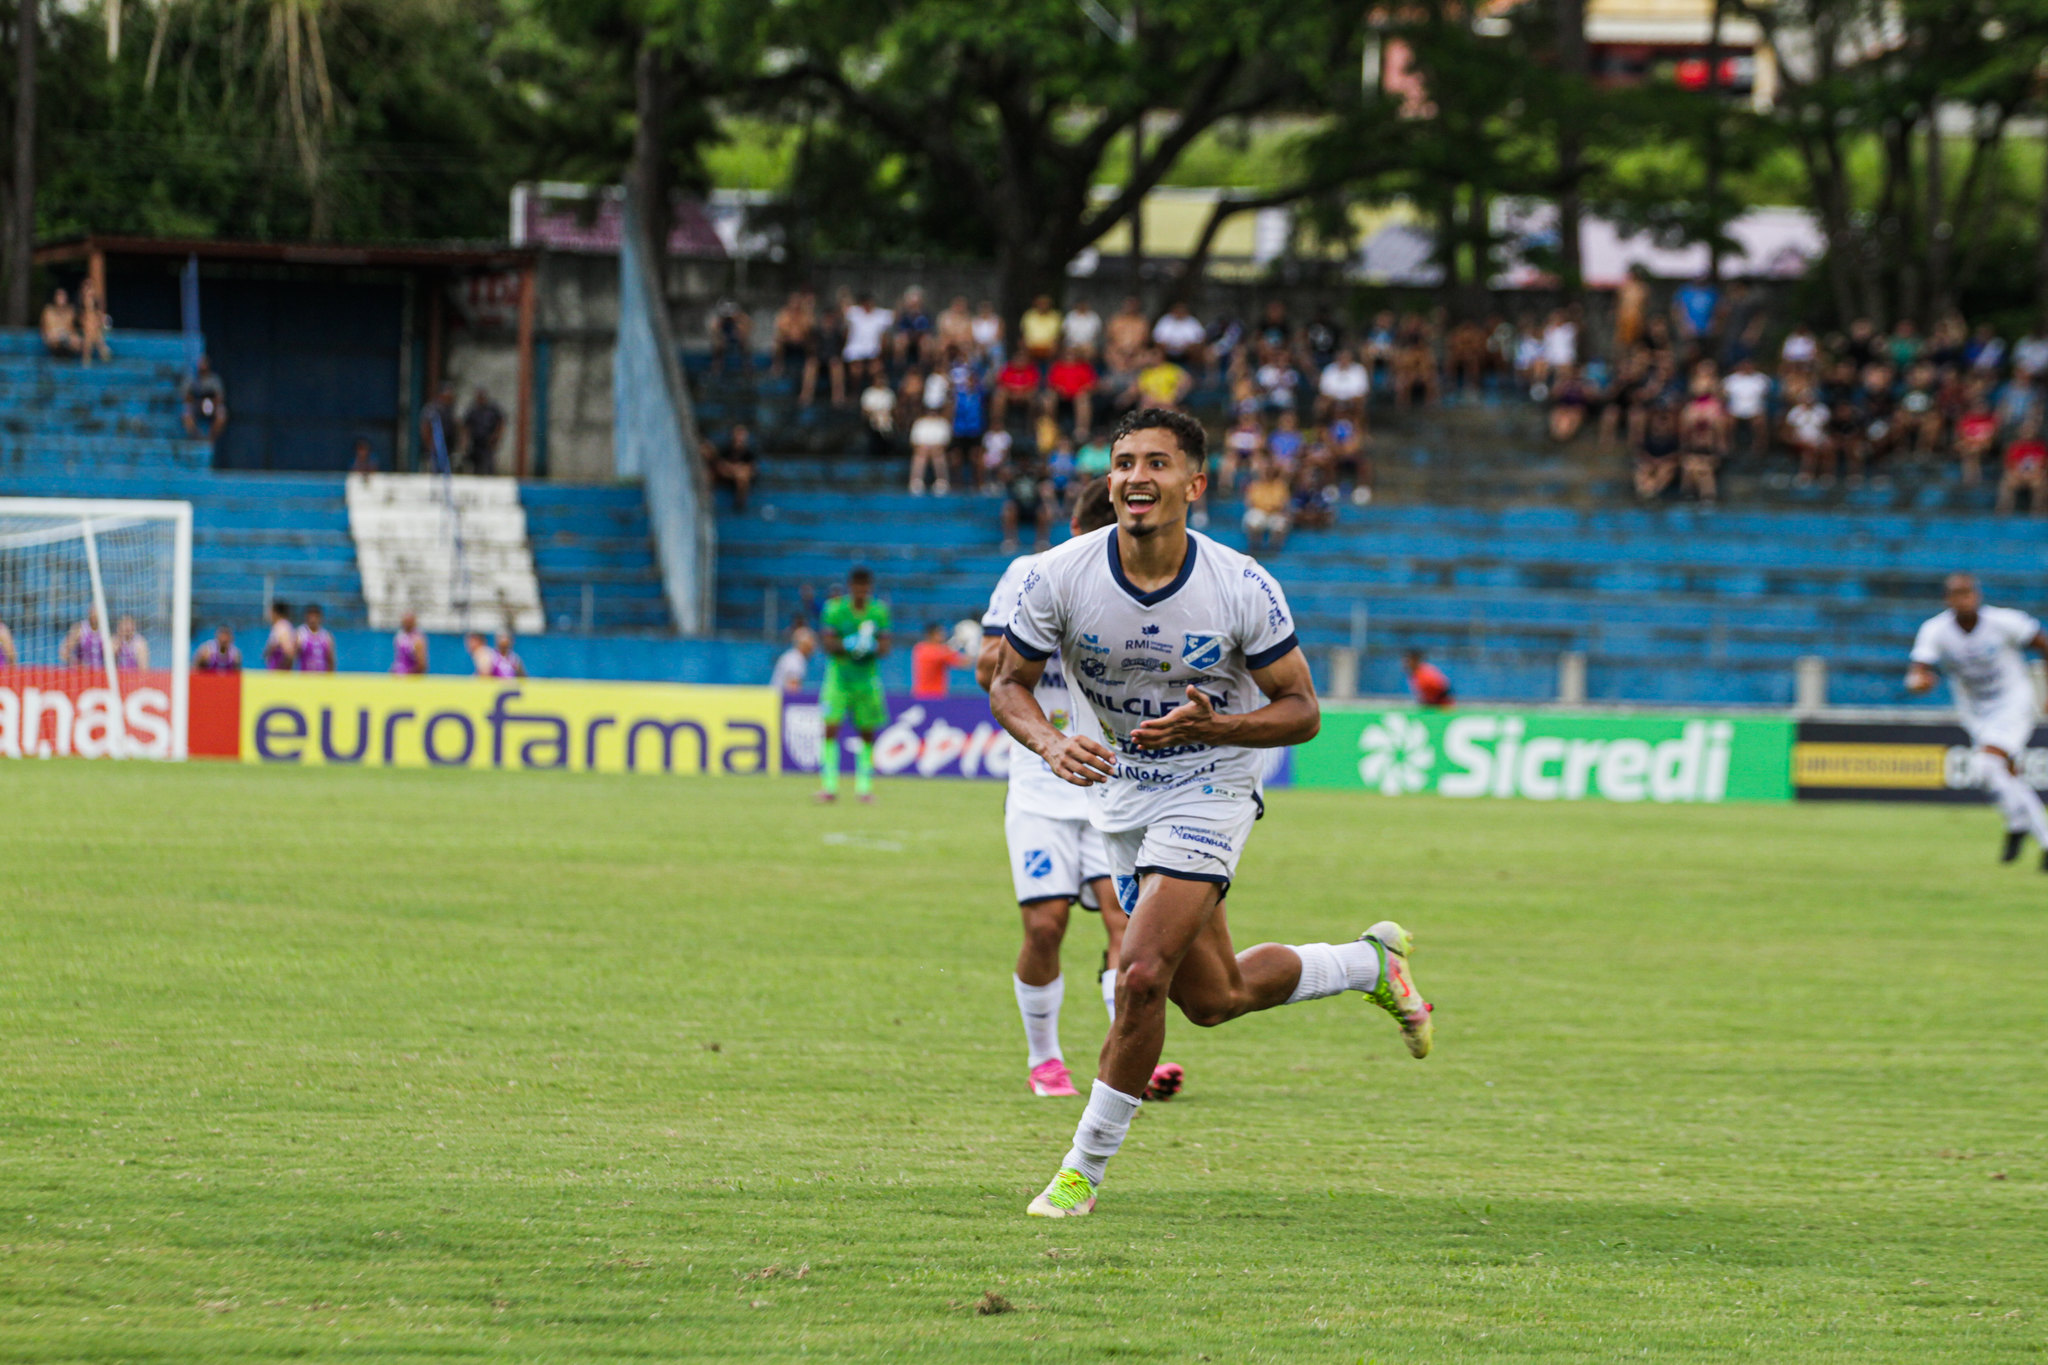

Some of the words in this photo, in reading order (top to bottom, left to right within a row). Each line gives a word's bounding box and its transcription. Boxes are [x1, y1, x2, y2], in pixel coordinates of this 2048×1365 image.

[1124, 639, 1150, 650] RMI
[1077, 679, 1229, 719] MILCLEN
[253, 690, 765, 773] eurofarma
[1437, 713, 1735, 802] Sicredi
